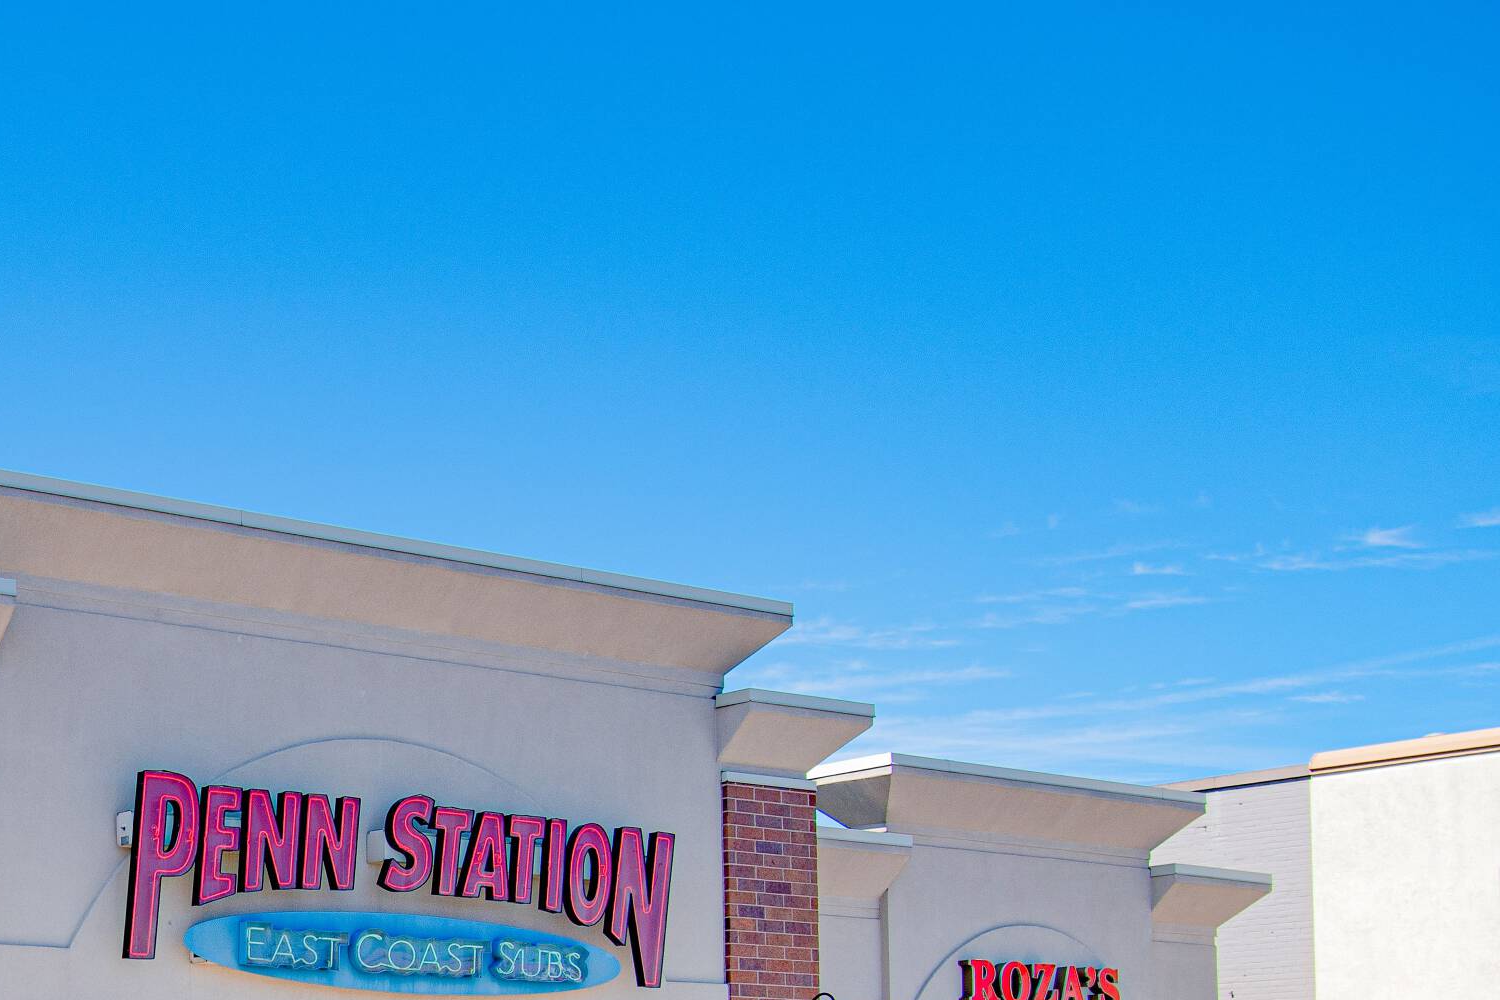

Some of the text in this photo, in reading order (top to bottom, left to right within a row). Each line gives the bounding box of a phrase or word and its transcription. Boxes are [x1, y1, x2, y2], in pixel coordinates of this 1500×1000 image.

[122, 769, 676, 988] PENN STATION
[242, 923, 587, 983] EAST COAST SUBS
